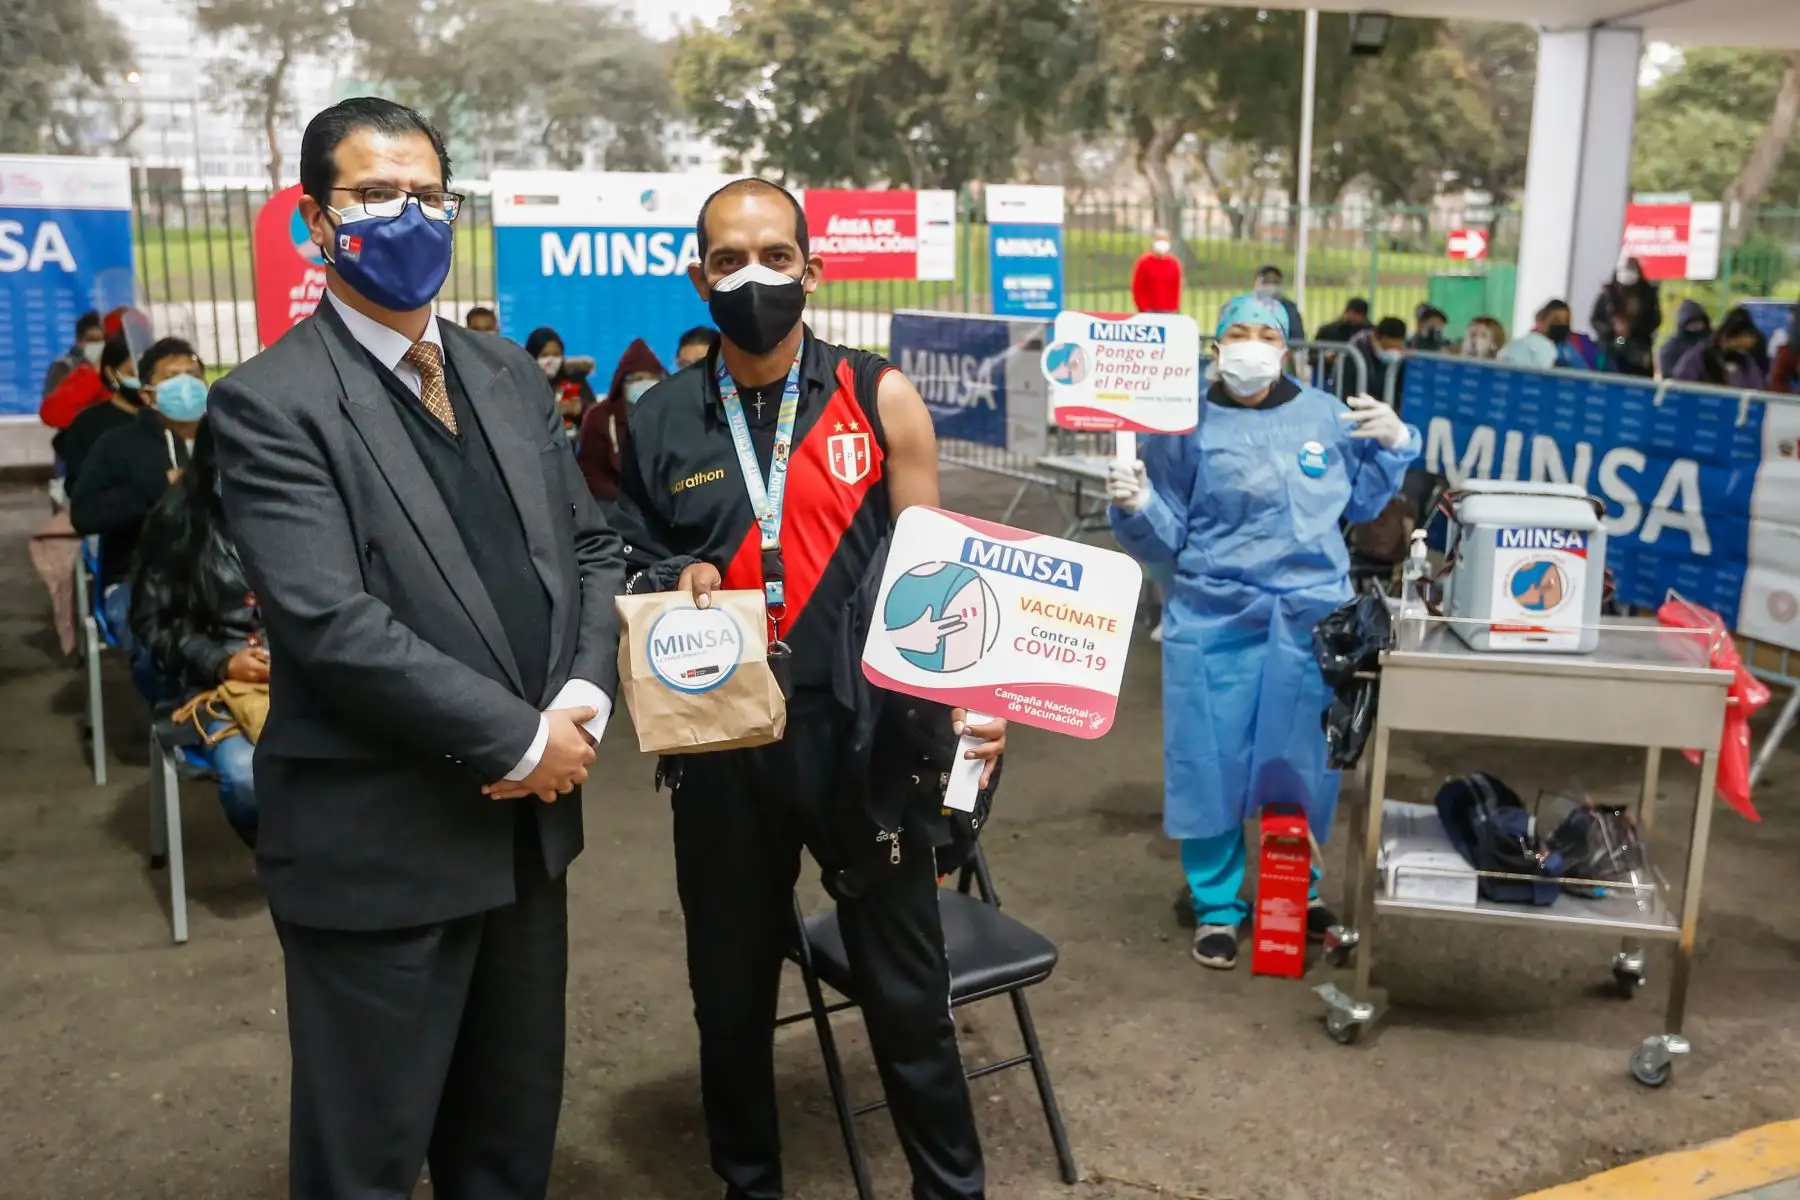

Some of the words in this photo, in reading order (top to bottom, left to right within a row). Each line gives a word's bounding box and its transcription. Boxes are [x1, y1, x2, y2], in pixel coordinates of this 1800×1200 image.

[1093, 322, 1162, 343] MINSA
[1096, 344, 1145, 361] Pongo
[1151, 347, 1166, 360] el
[1094, 376, 1110, 389] el
[1115, 376, 1151, 390] Perú
[1095, 360, 1159, 375] hombro
[1163, 365, 1192, 380] por
[1425, 416, 1711, 556] MINSA
[1502, 528, 1584, 549] MINSA
[969, 539, 1075, 588] MINSA
[1020, 597, 1118, 633] VACÚNATE
[653, 628, 736, 657] MINSA
[1030, 626, 1078, 647] Contra
[1082, 638, 1095, 651] la
[1013, 636, 1107, 671] COVID-19
[994, 687, 1042, 708] Campaña
[1044, 699, 1089, 719] Nacional
[1008, 701, 1022, 712] de
[1024, 705, 1084, 728] Vacunación
